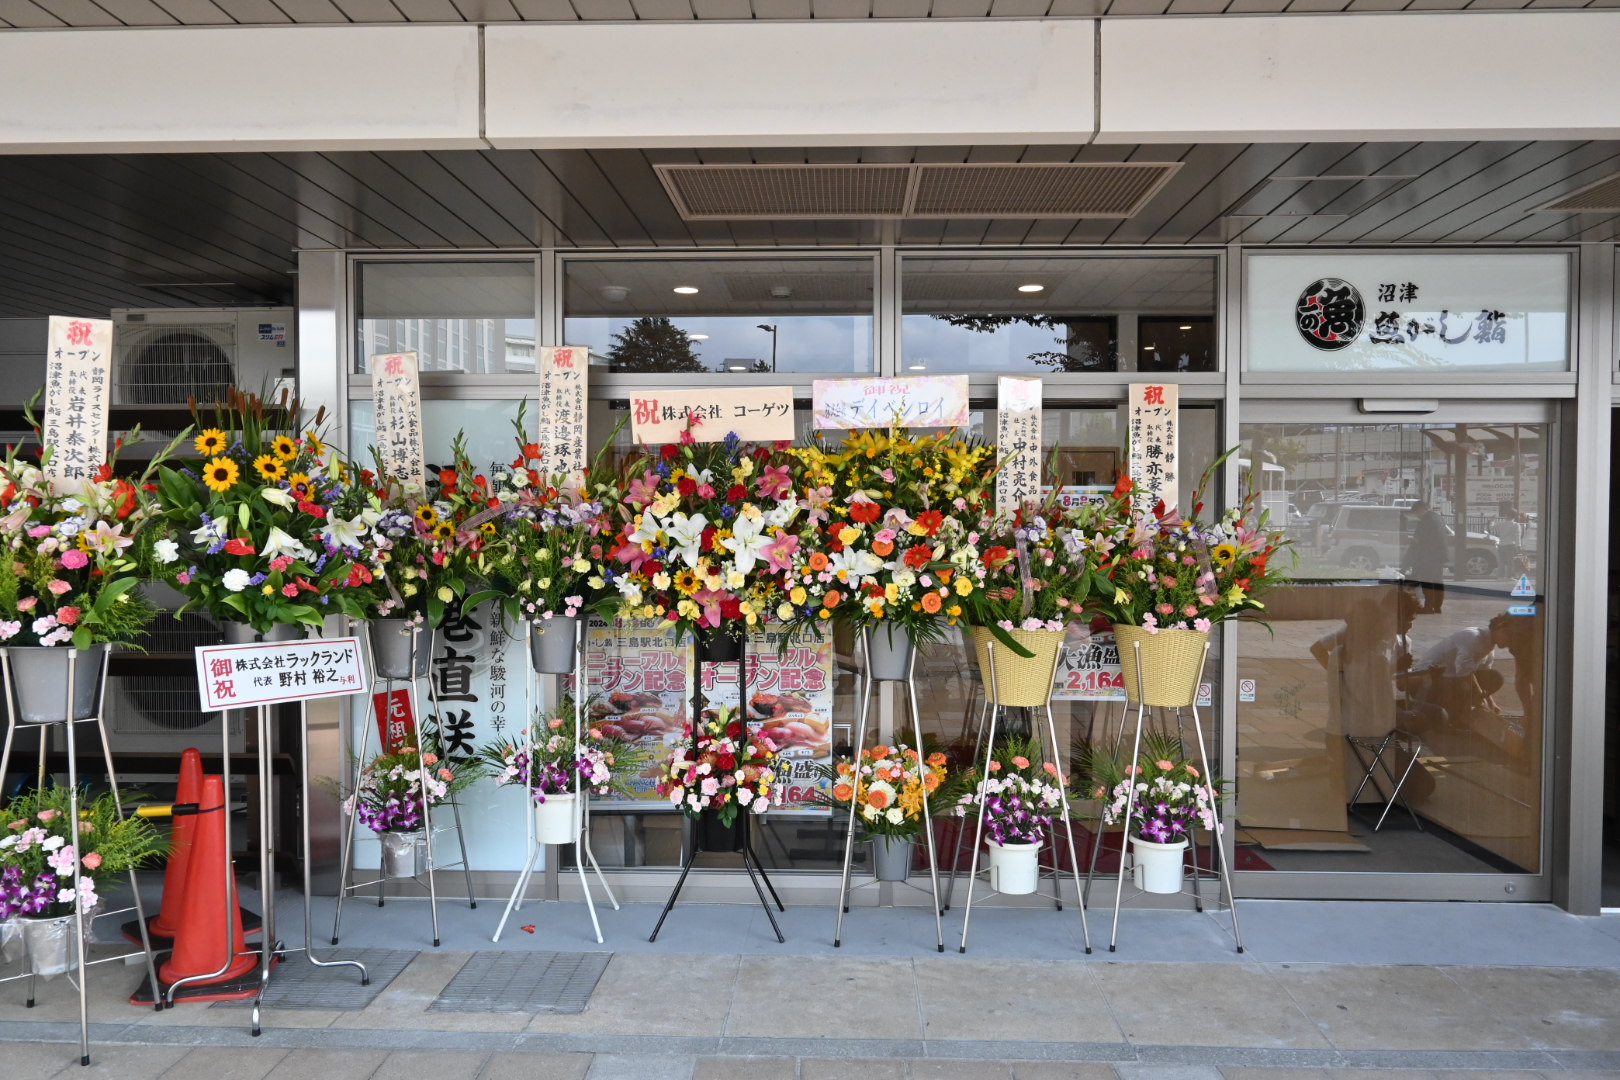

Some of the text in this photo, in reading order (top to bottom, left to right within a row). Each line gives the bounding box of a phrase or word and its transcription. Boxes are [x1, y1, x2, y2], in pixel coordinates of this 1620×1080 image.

[1378, 282, 1419, 304] 沼津
[67, 320, 94, 346] 祝
[54, 347, 101, 362] オープン
[553, 348, 574, 369] 祝
[385, 356, 404, 375] 祝
[545, 371, 580, 380] オープン
[377, 378, 412, 388] オープン
[1144, 386, 1165, 405] 祝
[633, 399, 790, 425] 祝 株式会社 コーゲツ
[1135, 406, 1171, 416] オープン
[64, 396, 87, 480] 岩井泰次郎
[390, 416, 410, 481] 杉山博志
[1012, 437, 1028, 503] 中村亮介
[235, 649, 353, 672] 株式会社ラックランド
[253, 676, 273, 687] 代表
[279, 672, 307, 687] 野村
